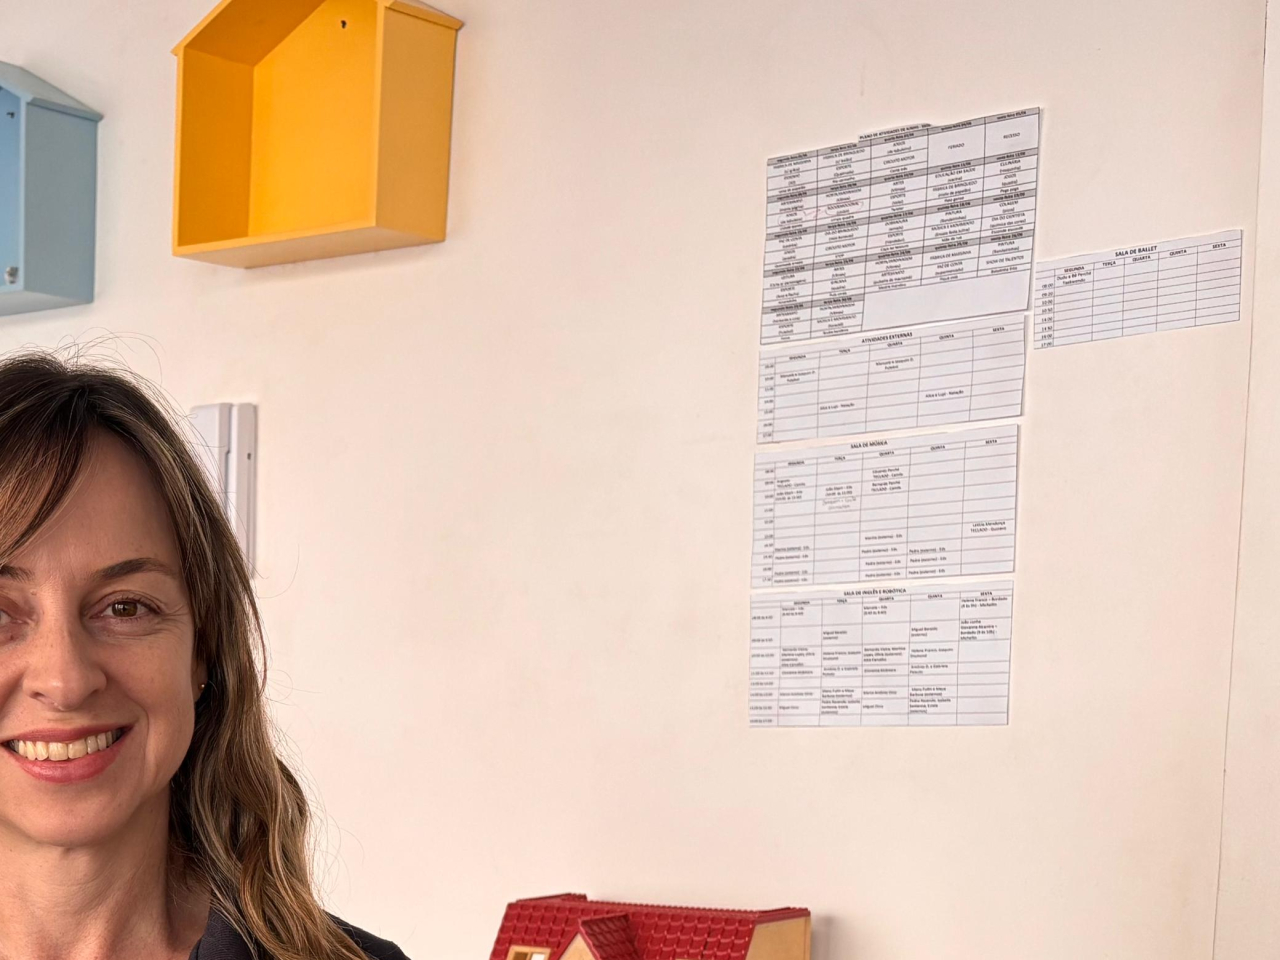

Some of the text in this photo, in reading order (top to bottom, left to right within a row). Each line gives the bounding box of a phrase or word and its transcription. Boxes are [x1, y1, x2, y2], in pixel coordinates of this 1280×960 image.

[1138, 245, 1157, 253] BALLET
[862, 332, 912, 344] ATIVIDADES EXTERNAS
[870, 440, 888, 448] MÚSICA
